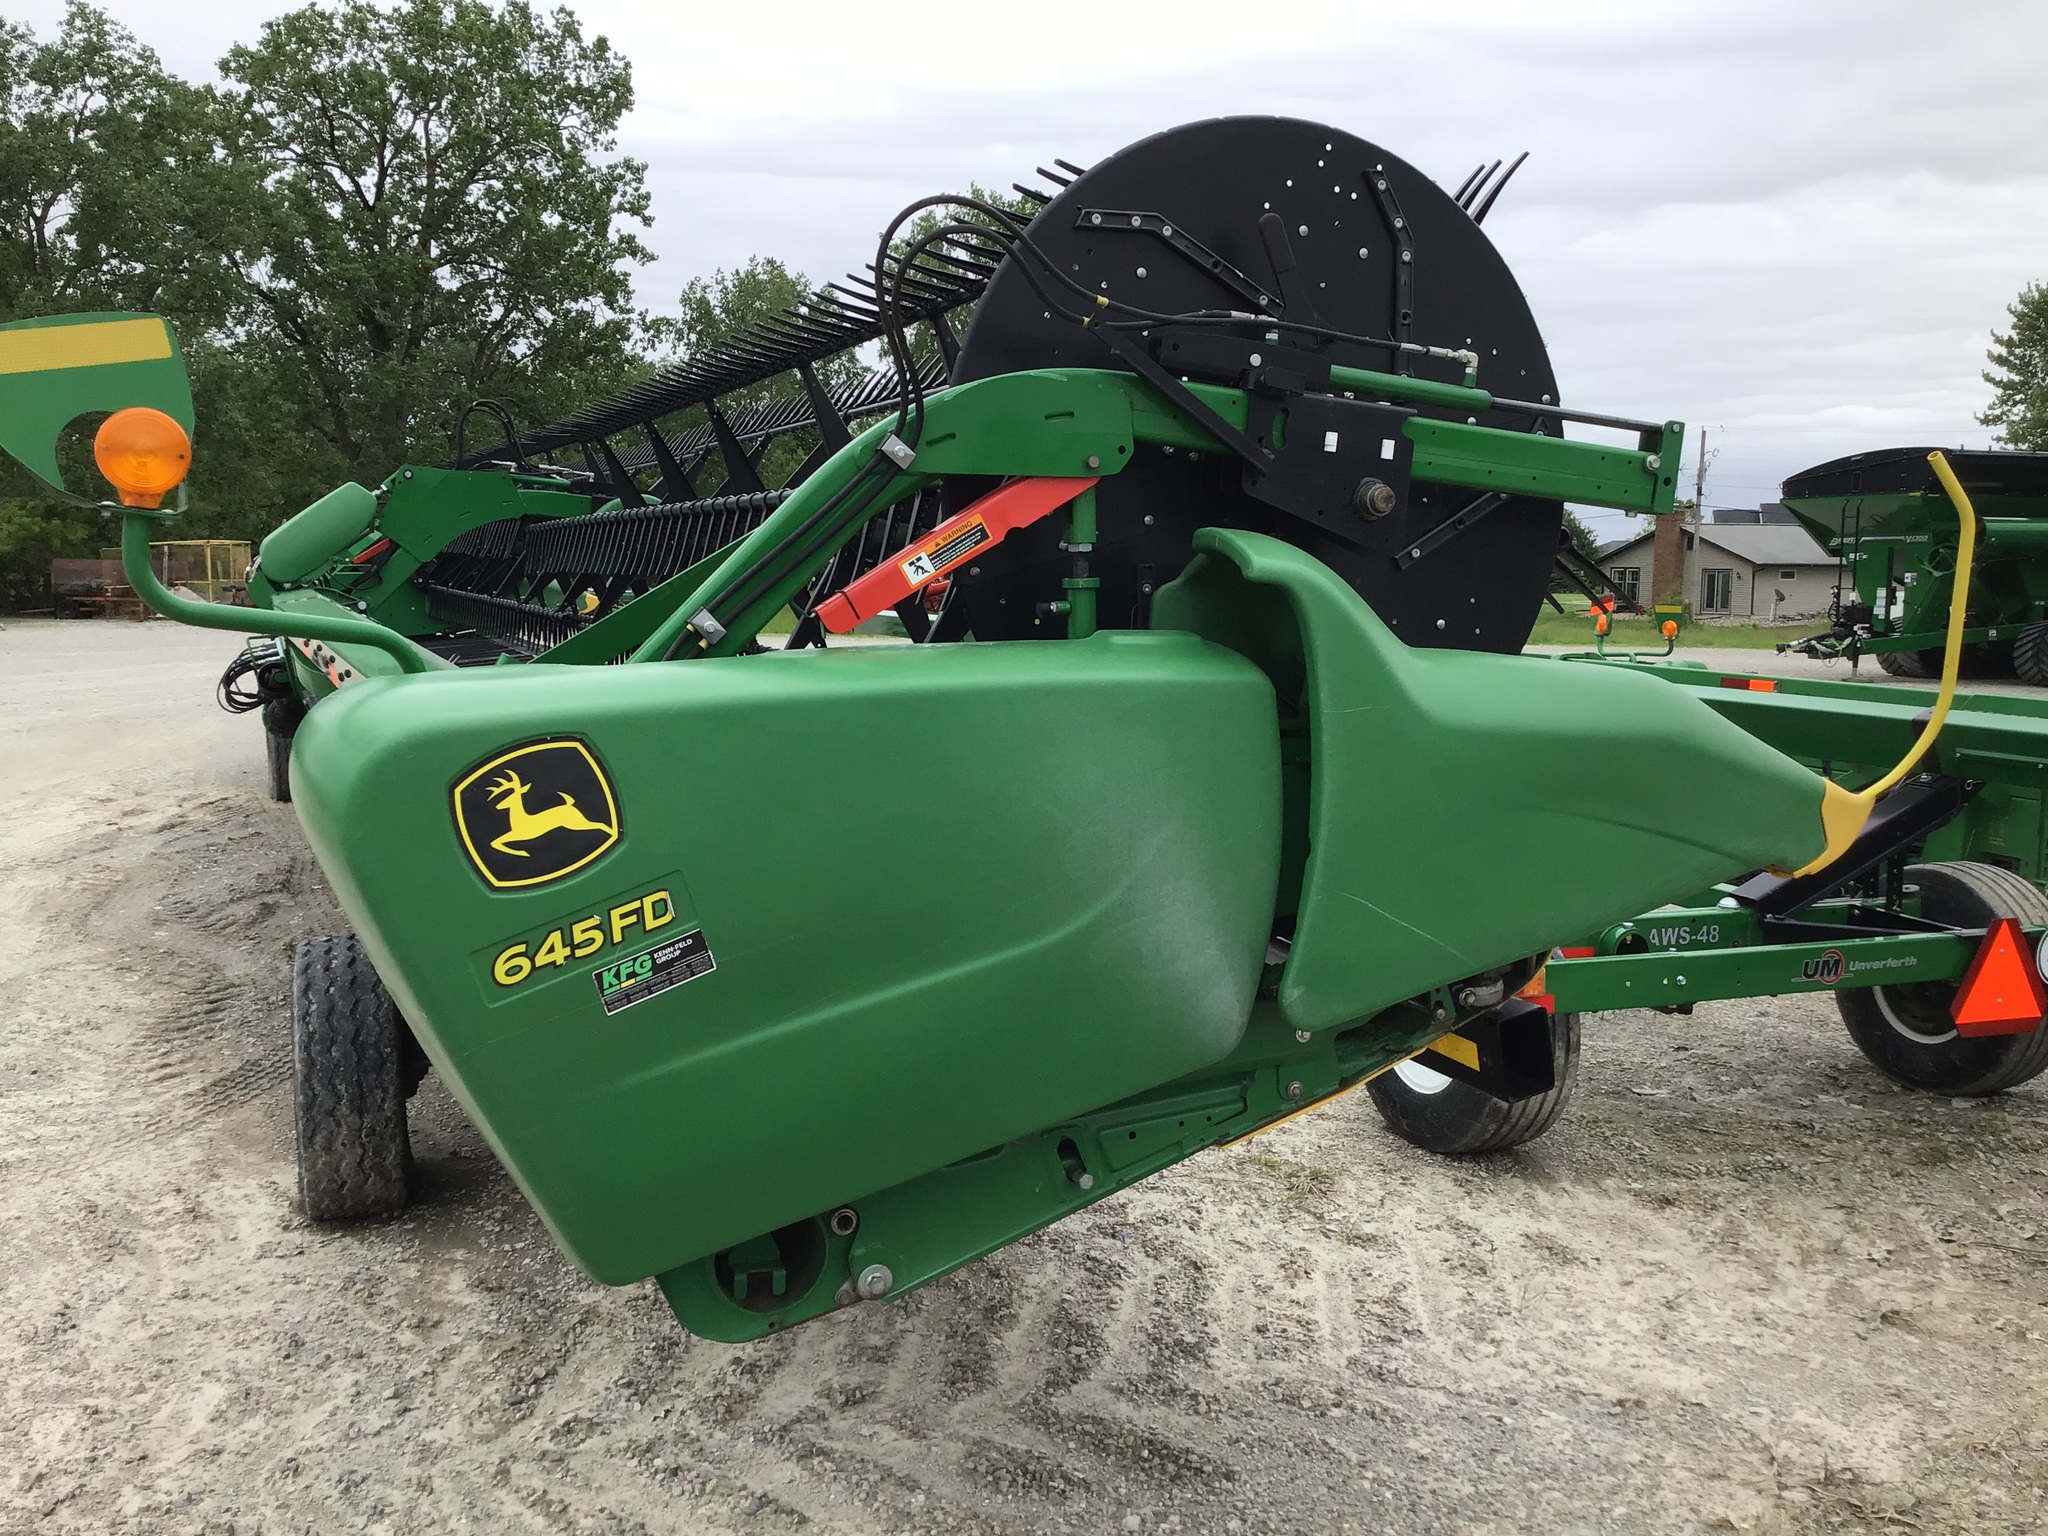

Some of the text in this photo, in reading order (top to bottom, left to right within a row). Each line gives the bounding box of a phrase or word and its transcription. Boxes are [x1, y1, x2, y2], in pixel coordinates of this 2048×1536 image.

[941, 520, 972, 543] WARNING
[491, 889, 675, 987] 645FD
[1649, 925, 1720, 946] AWS-48
[653, 938, 693, 959] KENN-FELD
[655, 950, 682, 965] GROUP
[602, 954, 652, 990] KFG
[1802, 956, 1918, 980] UM Unverferth
